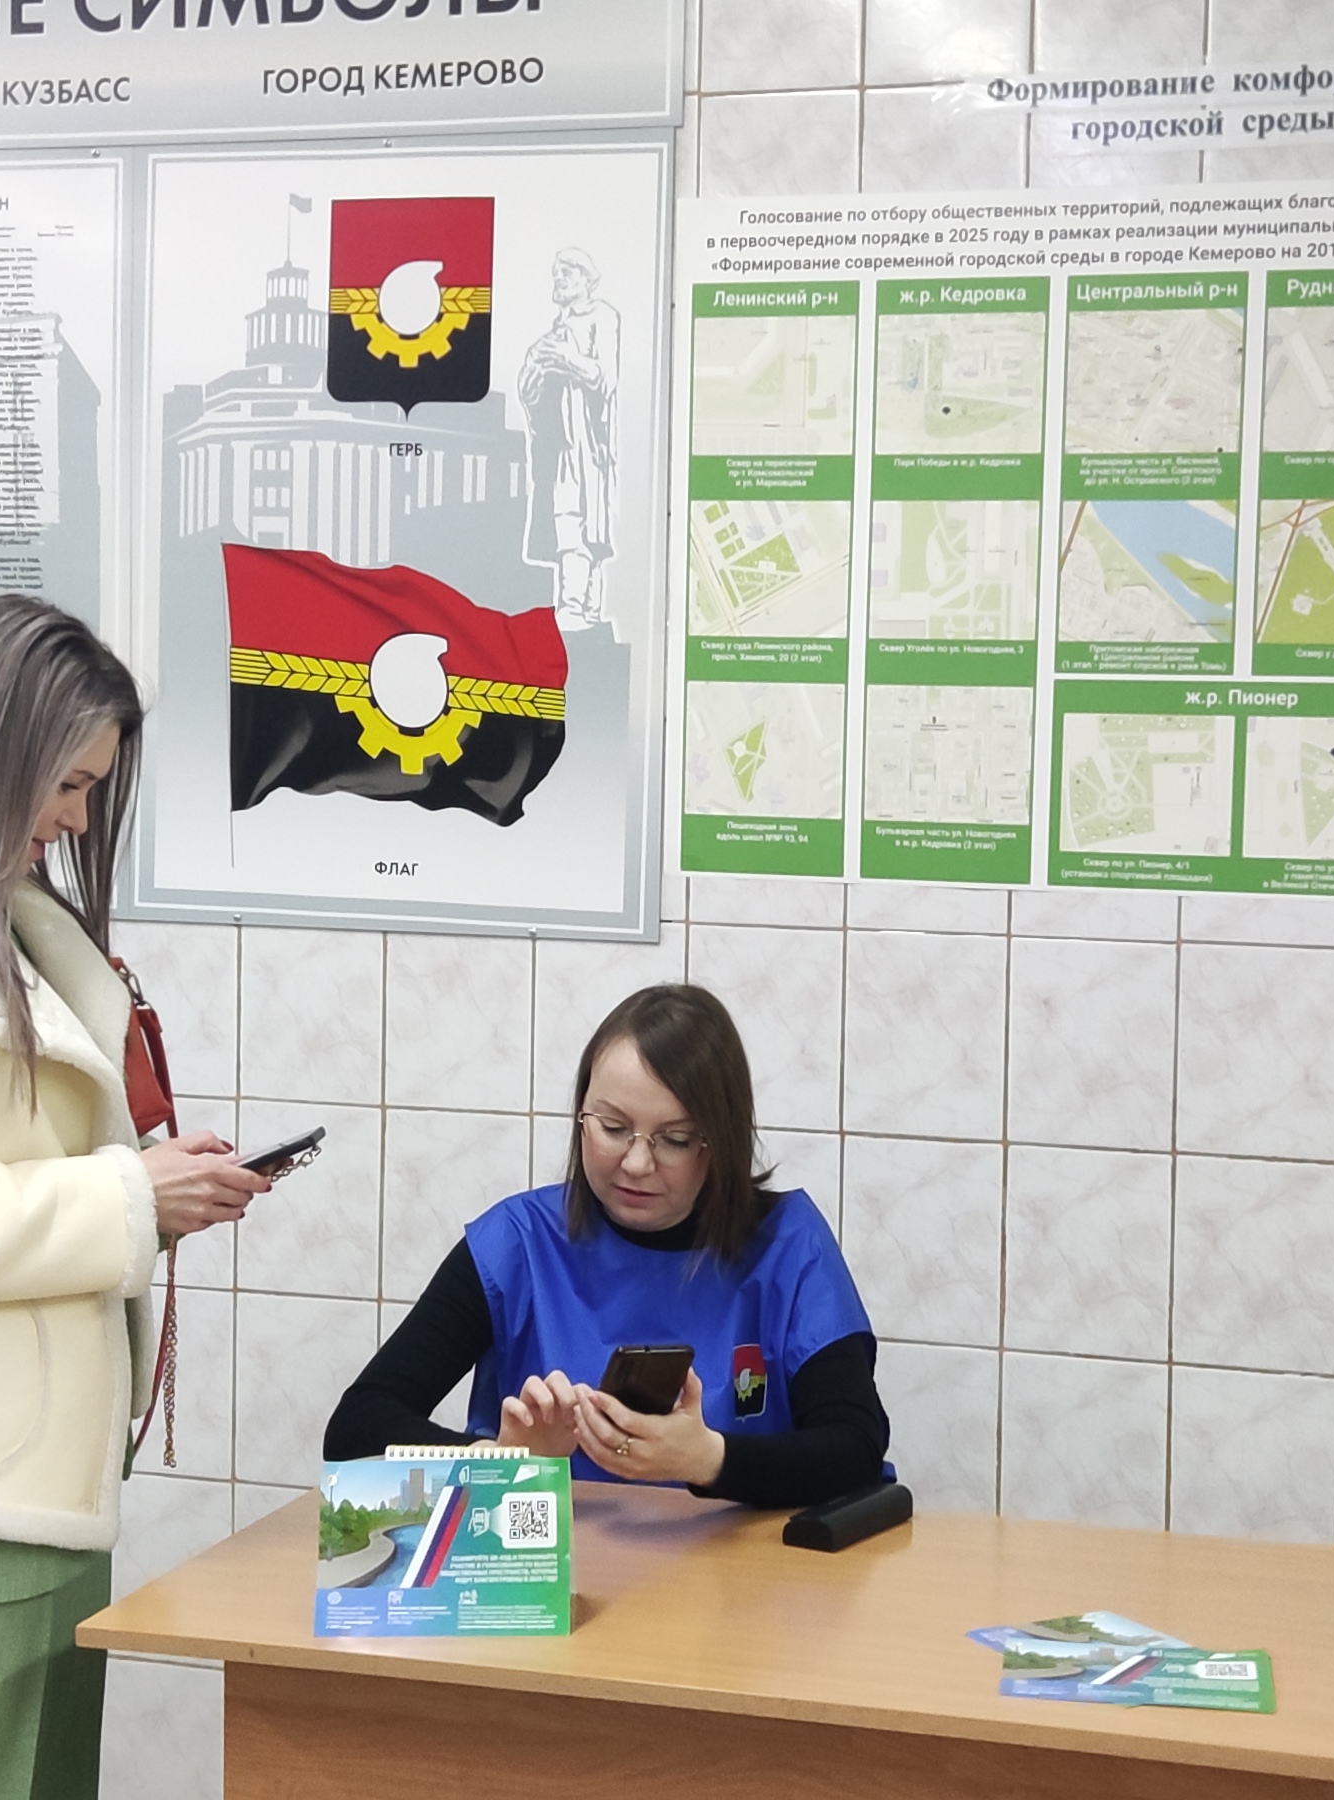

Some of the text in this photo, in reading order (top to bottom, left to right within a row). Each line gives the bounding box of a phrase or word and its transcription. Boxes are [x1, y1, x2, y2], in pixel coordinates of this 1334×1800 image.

[261, 56, 545, 97] ГОРОД КЕМЕРОВО
[986, 72, 1215, 108] Формирование
[2, 76, 132, 106] КУЗБАСС
[1071, 107, 1224, 146] городской
[740, 210, 843, 225] Голосование
[847, 210, 867, 222] по
[871, 205, 927, 224] отбору
[931, 204, 1057, 221] общественных
[1062, 198, 1165, 219] территорий,
[1169, 197, 1283, 216] подлежащих
[706, 237, 716, 249] в
[720, 234, 857, 251] первоочередном
[861, 232, 930, 248] порядке
[934, 232, 944, 243] в
[949, 227, 989, 243] 2025
[993, 230, 1030, 244] году
[1034, 229, 1044, 241] в
[1048, 227, 1111, 244] рамках
[1115, 224, 1218, 242] реализации
[711, 257, 841, 275] «Формирование
[844, 252, 954, 272] современной
[959, 250, 1046, 270] городской
[1050, 251, 1105, 268] среды
[1110, 251, 1120, 263] в
[1125, 249, 1184, 266] городе
[1188, 245, 1276, 264] Кемерово
[1281, 246, 1302, 259] на
[713, 289, 838, 309] Ленинский р-н
[899, 286, 1027, 307] ж.р. Кедровка
[1076, 281, 1238, 303] Центральный р-н
[388, 442, 424, 457] ГЕРБ
[1185, 688, 1299, 709] ж.р. Пионер
[373, 861, 419, 878] ФЛАГ
